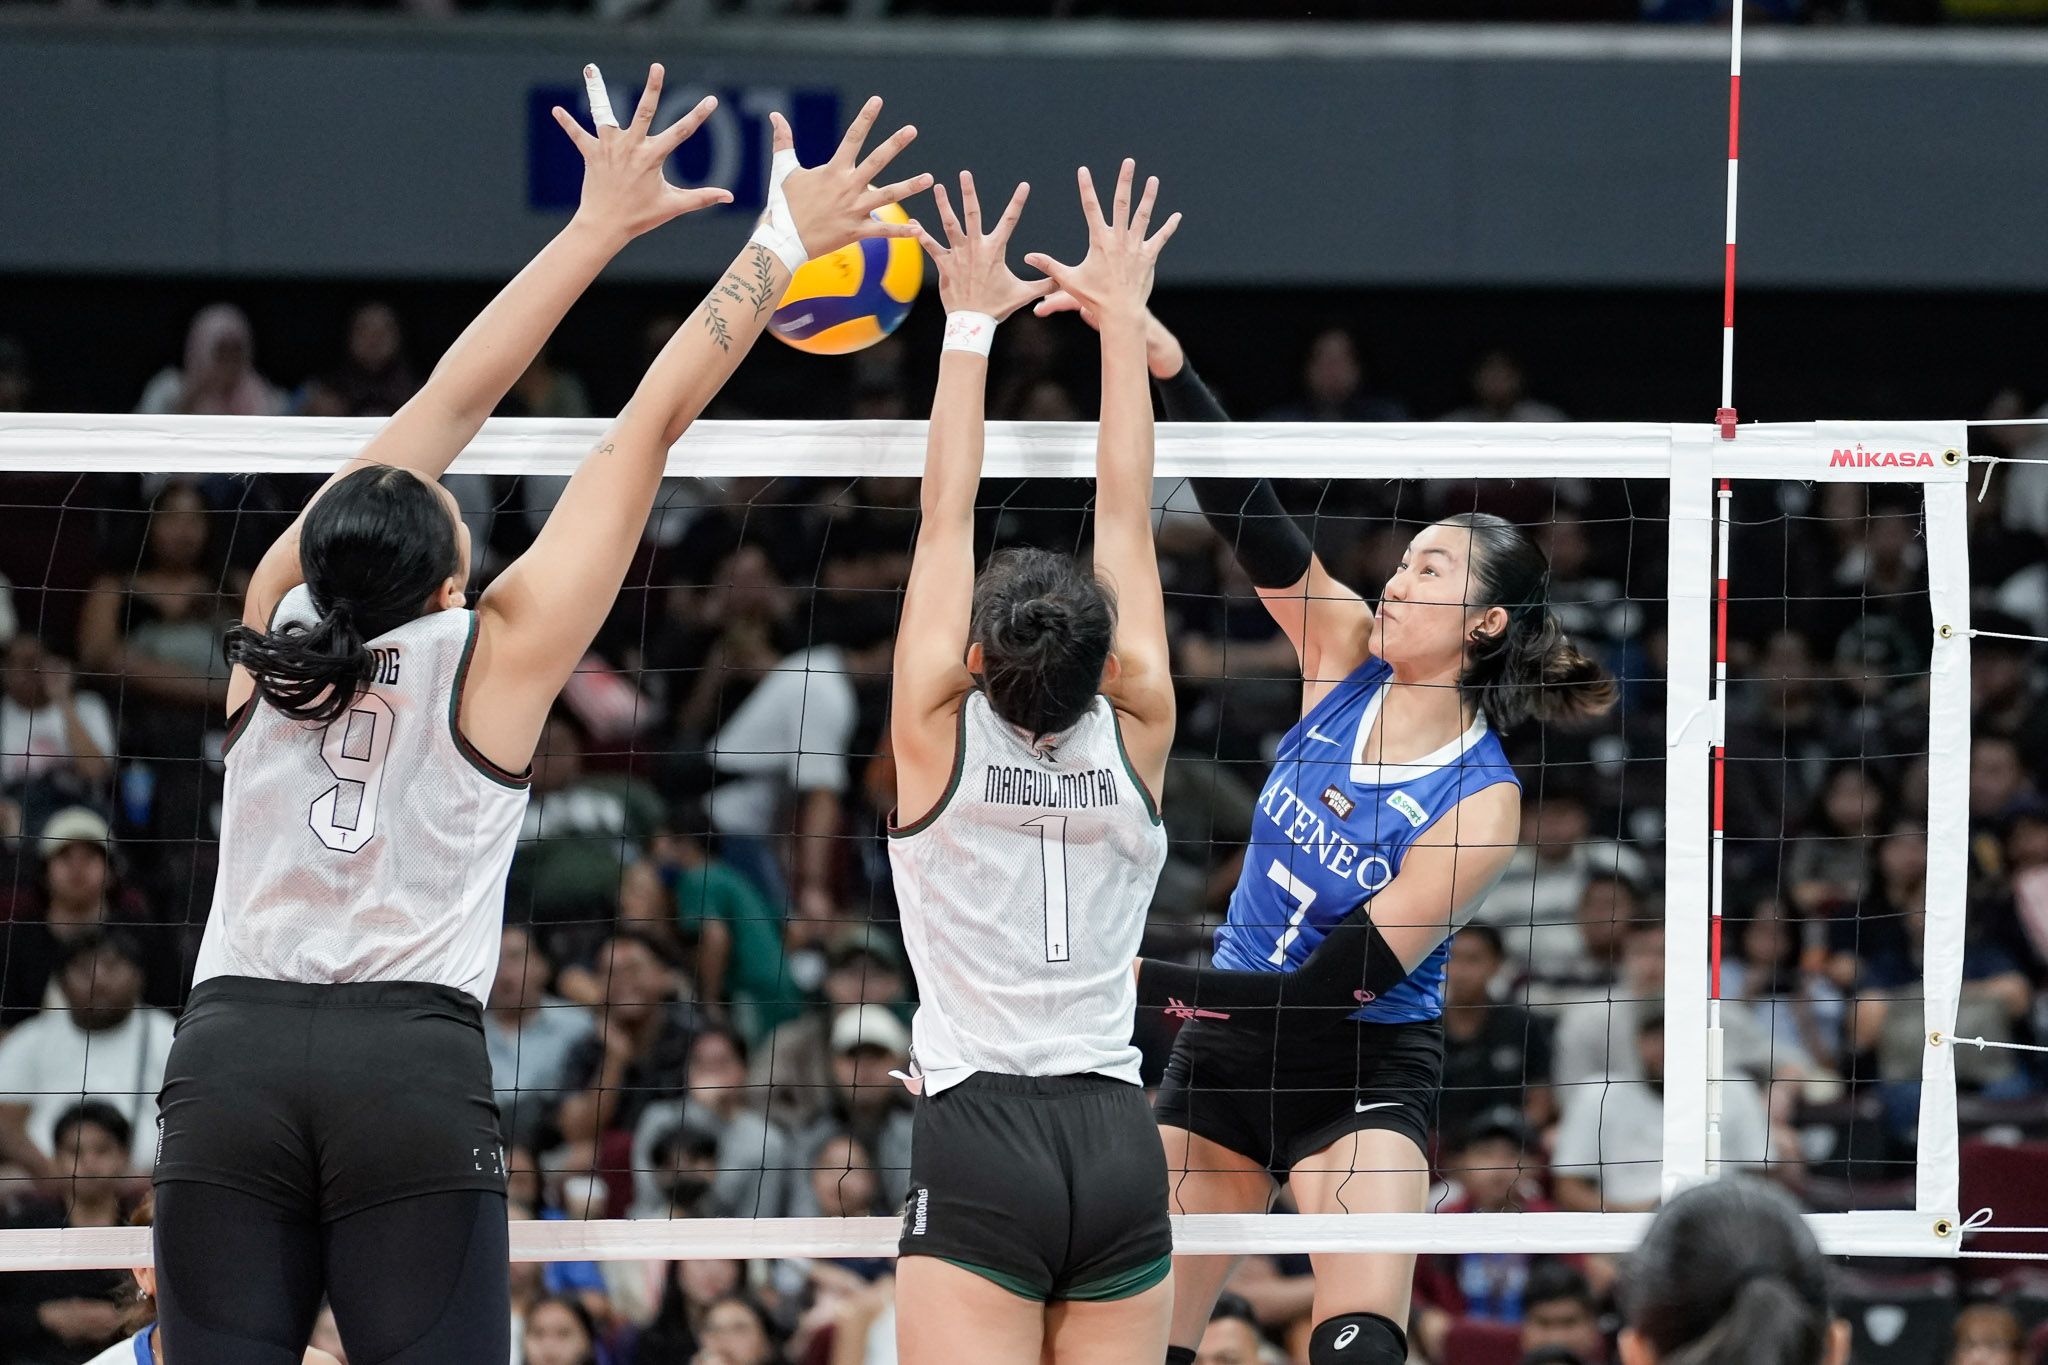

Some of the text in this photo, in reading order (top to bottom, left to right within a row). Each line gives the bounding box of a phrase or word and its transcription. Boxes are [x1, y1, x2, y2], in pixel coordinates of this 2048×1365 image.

[308, 690, 396, 854] 9
[984, 765, 1119, 808] MANGUILIMOTAN
[1019, 814, 1070, 963] 1
[1258, 777, 1393, 891] ATENEO
[1266, 858, 1317, 966] 7
[912, 1188, 929, 1236] MAROONS
